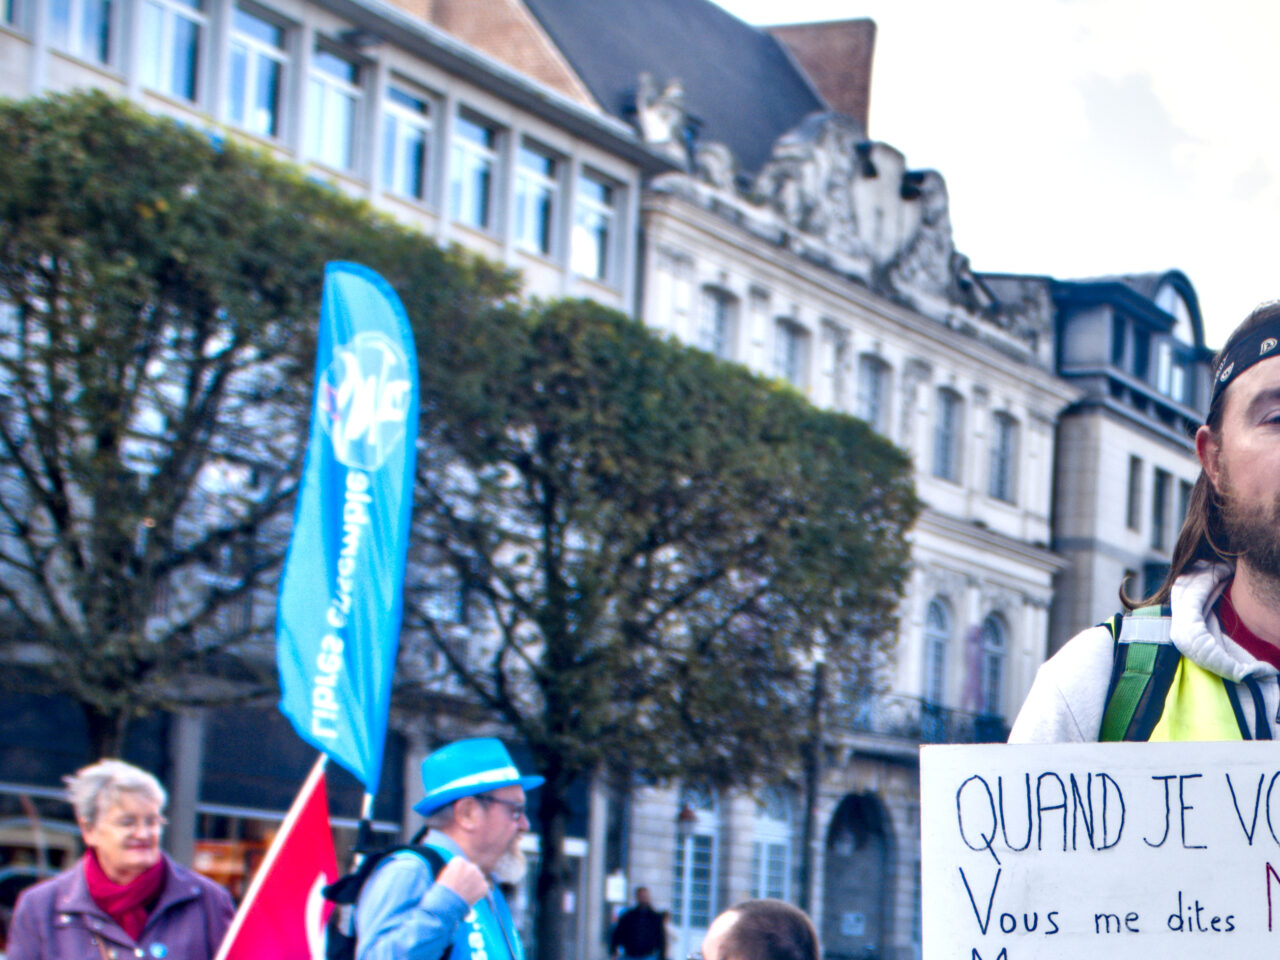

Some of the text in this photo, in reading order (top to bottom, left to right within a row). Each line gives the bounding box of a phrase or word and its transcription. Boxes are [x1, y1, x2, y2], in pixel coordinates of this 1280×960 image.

[956, 772, 1126, 866] QUAND
[1143, 773, 1208, 849] JE
[959, 866, 1060, 936] Vous
[1095, 912, 1141, 935] me
[1167, 890, 1236, 935] dites
